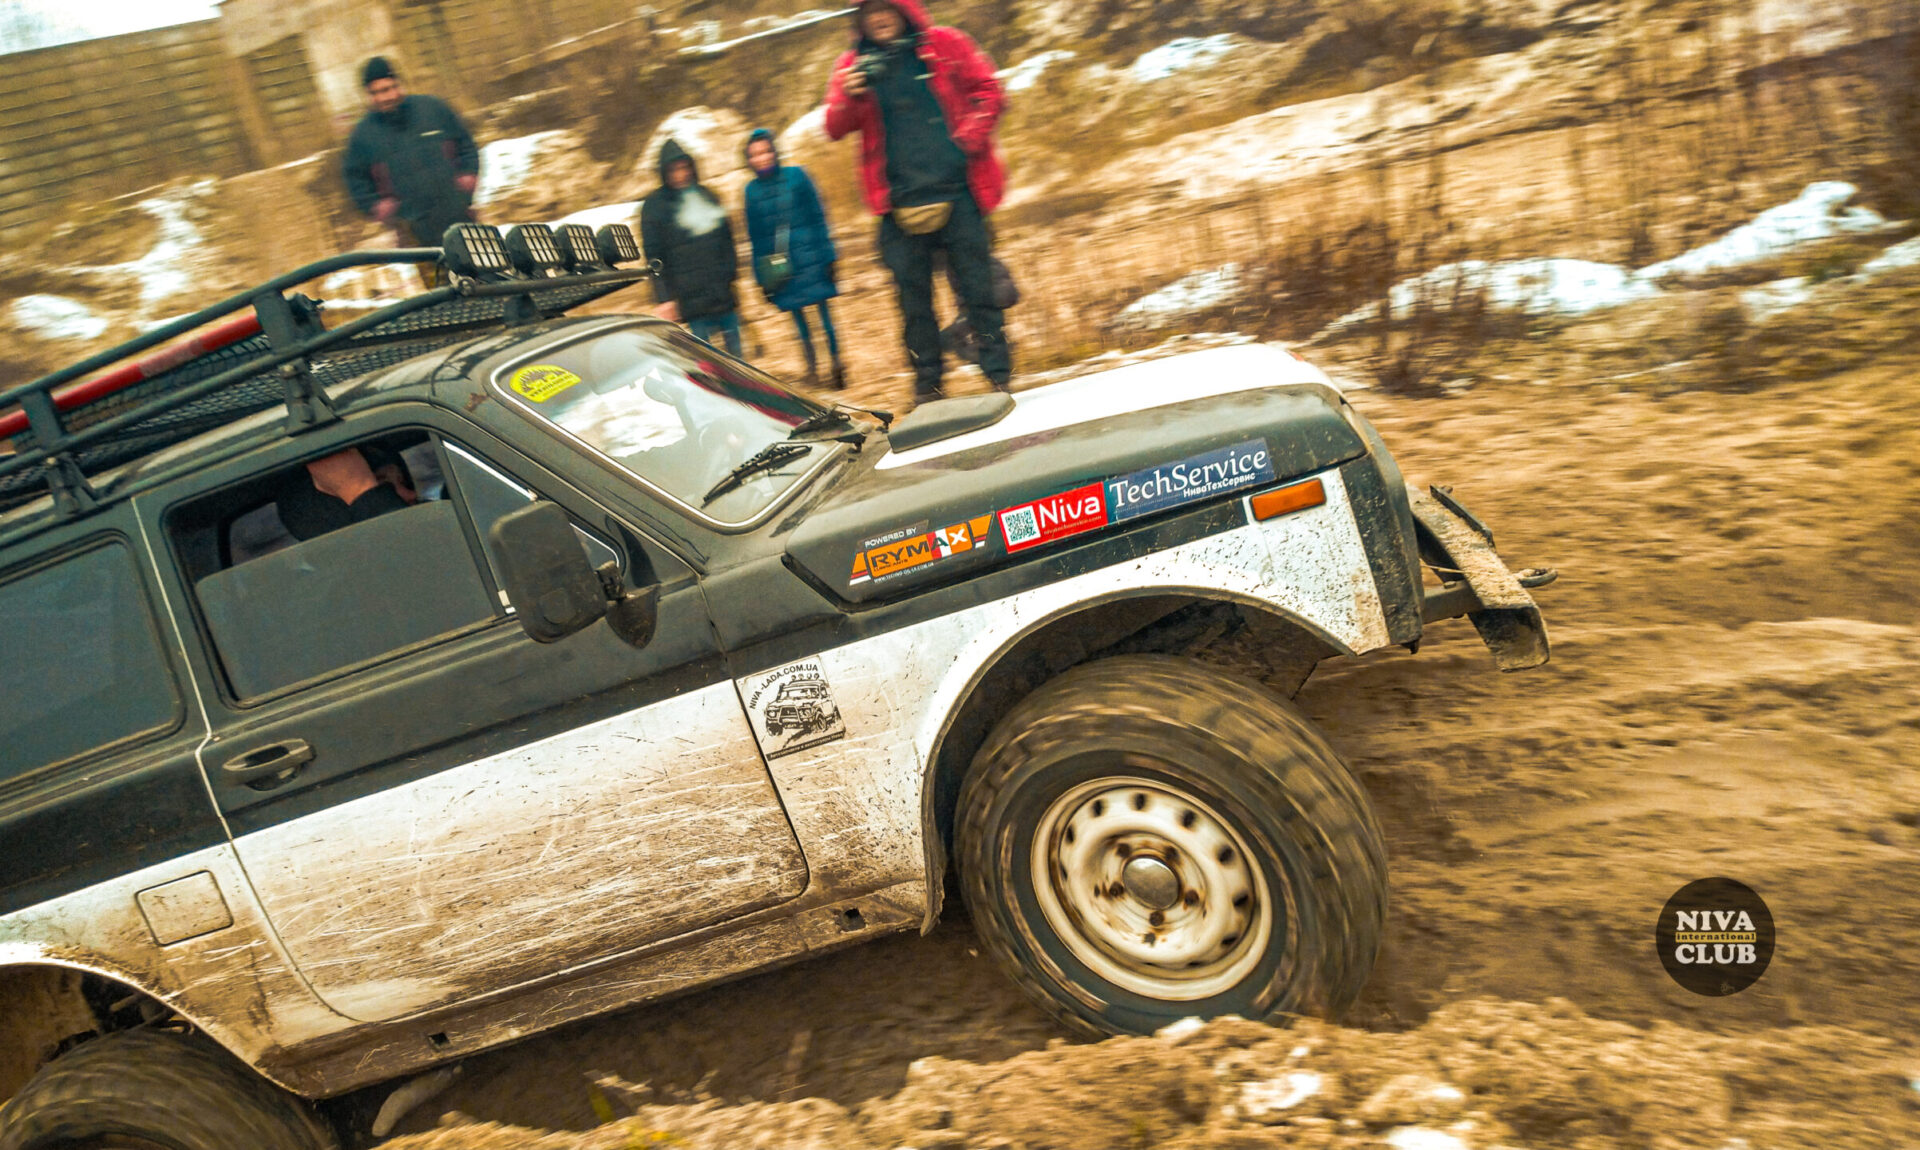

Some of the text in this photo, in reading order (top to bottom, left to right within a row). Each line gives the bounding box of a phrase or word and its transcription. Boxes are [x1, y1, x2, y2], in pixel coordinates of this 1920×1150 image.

[1039, 496, 1101, 529] Niva
[1108, 450, 1268, 508] TechService
[1183, 472, 1256, 498] НиваТехСервис
[864, 527, 917, 548] POWERED BY
[870, 528, 969, 569] RYMAX
